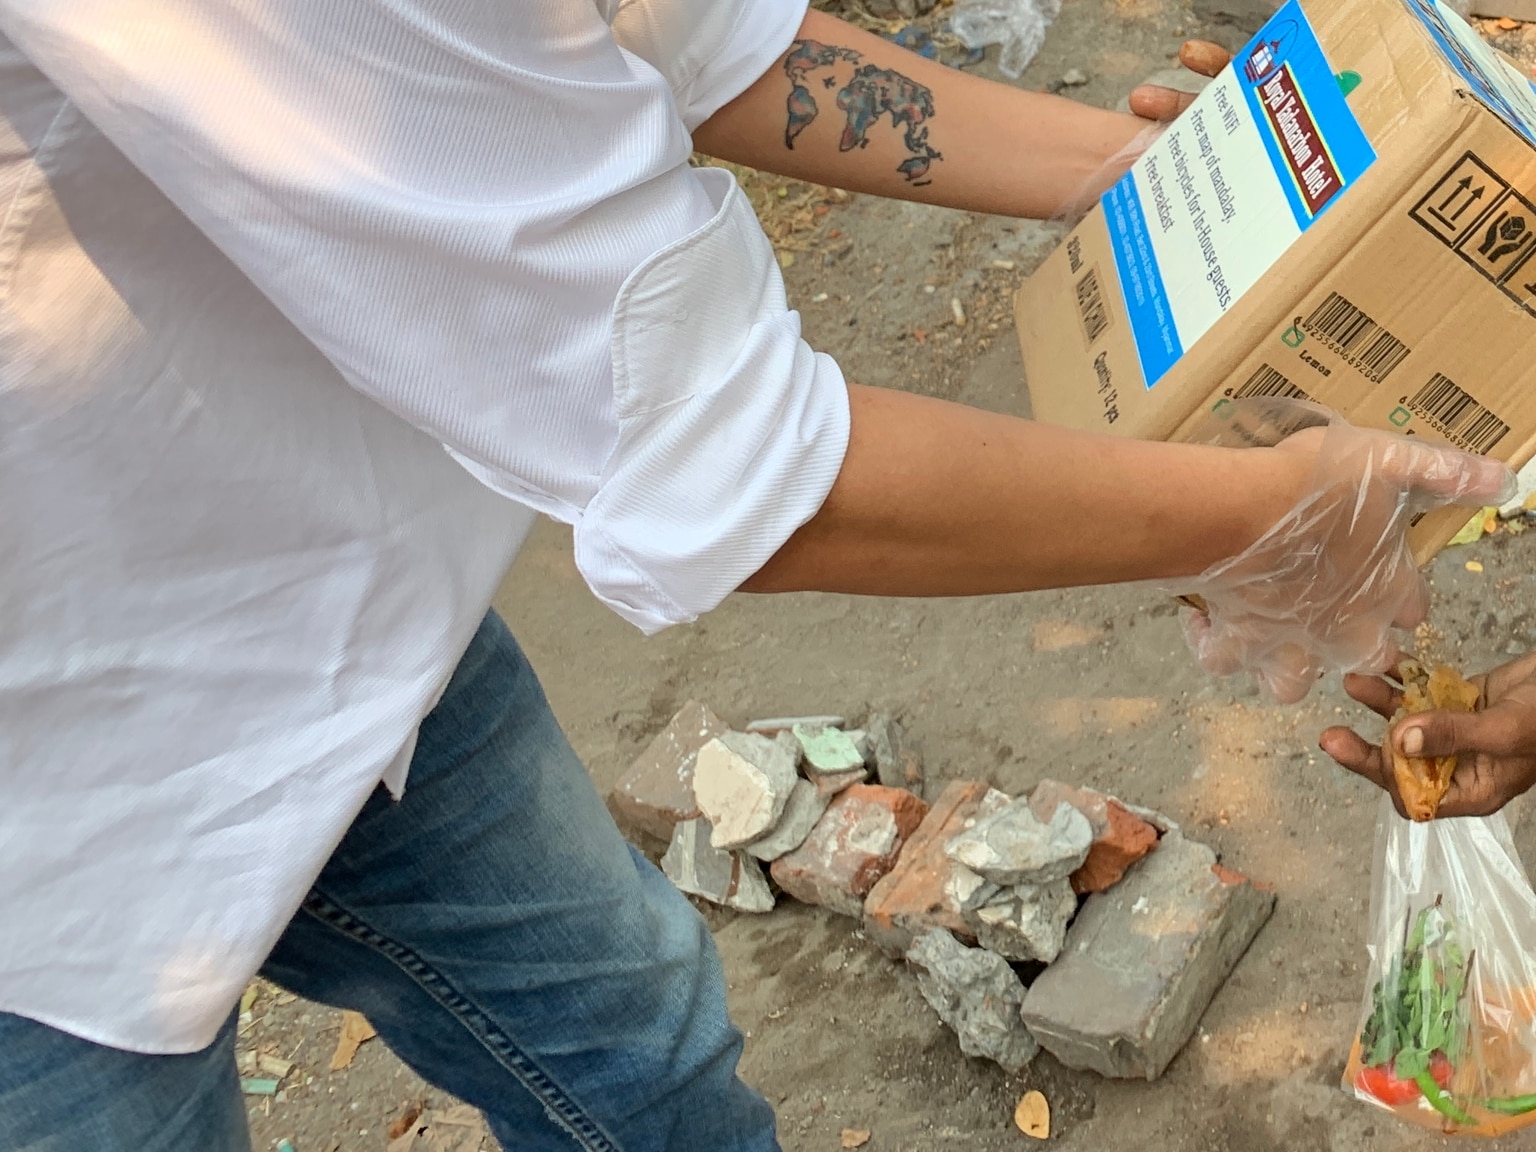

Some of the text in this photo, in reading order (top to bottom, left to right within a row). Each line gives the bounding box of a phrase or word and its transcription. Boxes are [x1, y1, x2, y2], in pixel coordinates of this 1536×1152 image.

[1222, 104, 1241, 136] WiFi
[1262, 69, 1332, 200] Royal Yadanarbon Hotel
[1196, 131, 1213, 159] map
[1173, 152, 1195, 200] bicycles
[1204, 154, 1220, 170] of
[1151, 176, 1175, 232] breakfast
[1186, 193, 1201, 217] for
[1192, 209, 1218, 268] In-House
[1206, 263, 1232, 311] guests.
[1075, 268, 1108, 343] MADE IN CHINA
[1298, 348, 1332, 377] Lemon
[1103, 387, 1118, 408] 12
[1103, 402, 1120, 425] pcs
